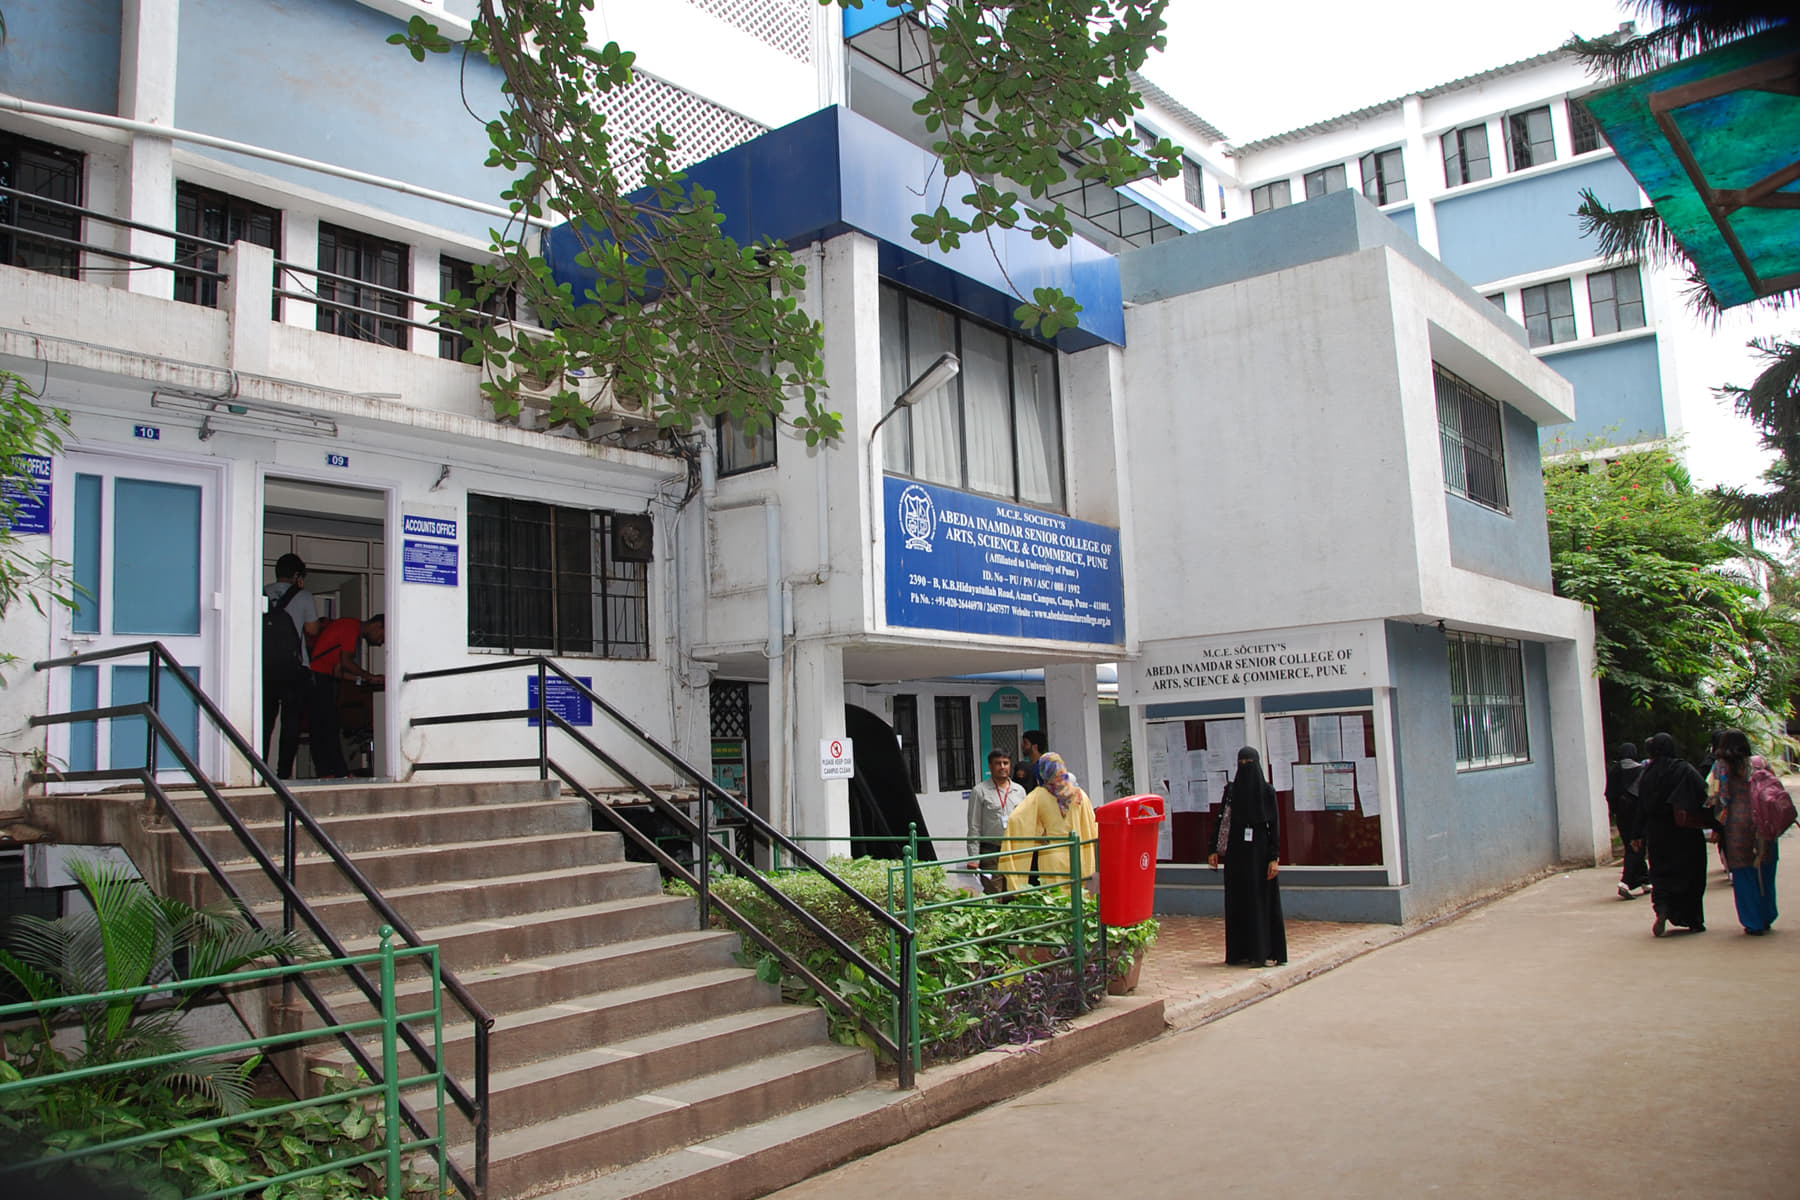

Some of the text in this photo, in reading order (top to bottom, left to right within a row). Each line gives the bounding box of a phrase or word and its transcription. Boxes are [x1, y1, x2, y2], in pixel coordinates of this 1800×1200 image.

[140, 427, 154, 438] 10
[28, 458, 50, 476] OFFICE
[332, 456, 344, 466] 09
[405, 518, 456, 536] ACCOUNTS OFFICE
[996, 506, 1066, 530] M.C.E. SOCIETY'S
[939, 510, 1112, 556] ABEDA INAMDAR SENIOR COLLEGE OF
[946, 528, 976, 547] ARTS,
[978, 533, 1020, 554] SCIENCE
[1022, 544, 1030, 555] &
[1031, 544, 1085, 568] COMMERCE,
[1087, 555, 1108, 570] PUNE
[990, 553, 1017, 567] Affiliated
[1018, 558, 1024, 567] to
[1026, 560, 1054, 575] University
[1062, 566, 1075, 577] Pune
[908, 574, 926, 587] 2390
[1016, 590, 1032, 602] Azam
[1075, 598, 1088, 609] Pune
[1009, 574, 1018, 585] PU
[1024, 576, 1033, 587] PN
[1037, 579, 1050, 590] ASC
[1202, 642, 1287, 658] M.C.E. SOCIETY'S
[1145, 648, 1353, 677] ABEDA INAMDAR SENIOR COLLEGE OF
[1152, 664, 1347, 691] ARTS, SCIENCE & COMMERCE, PUNE
